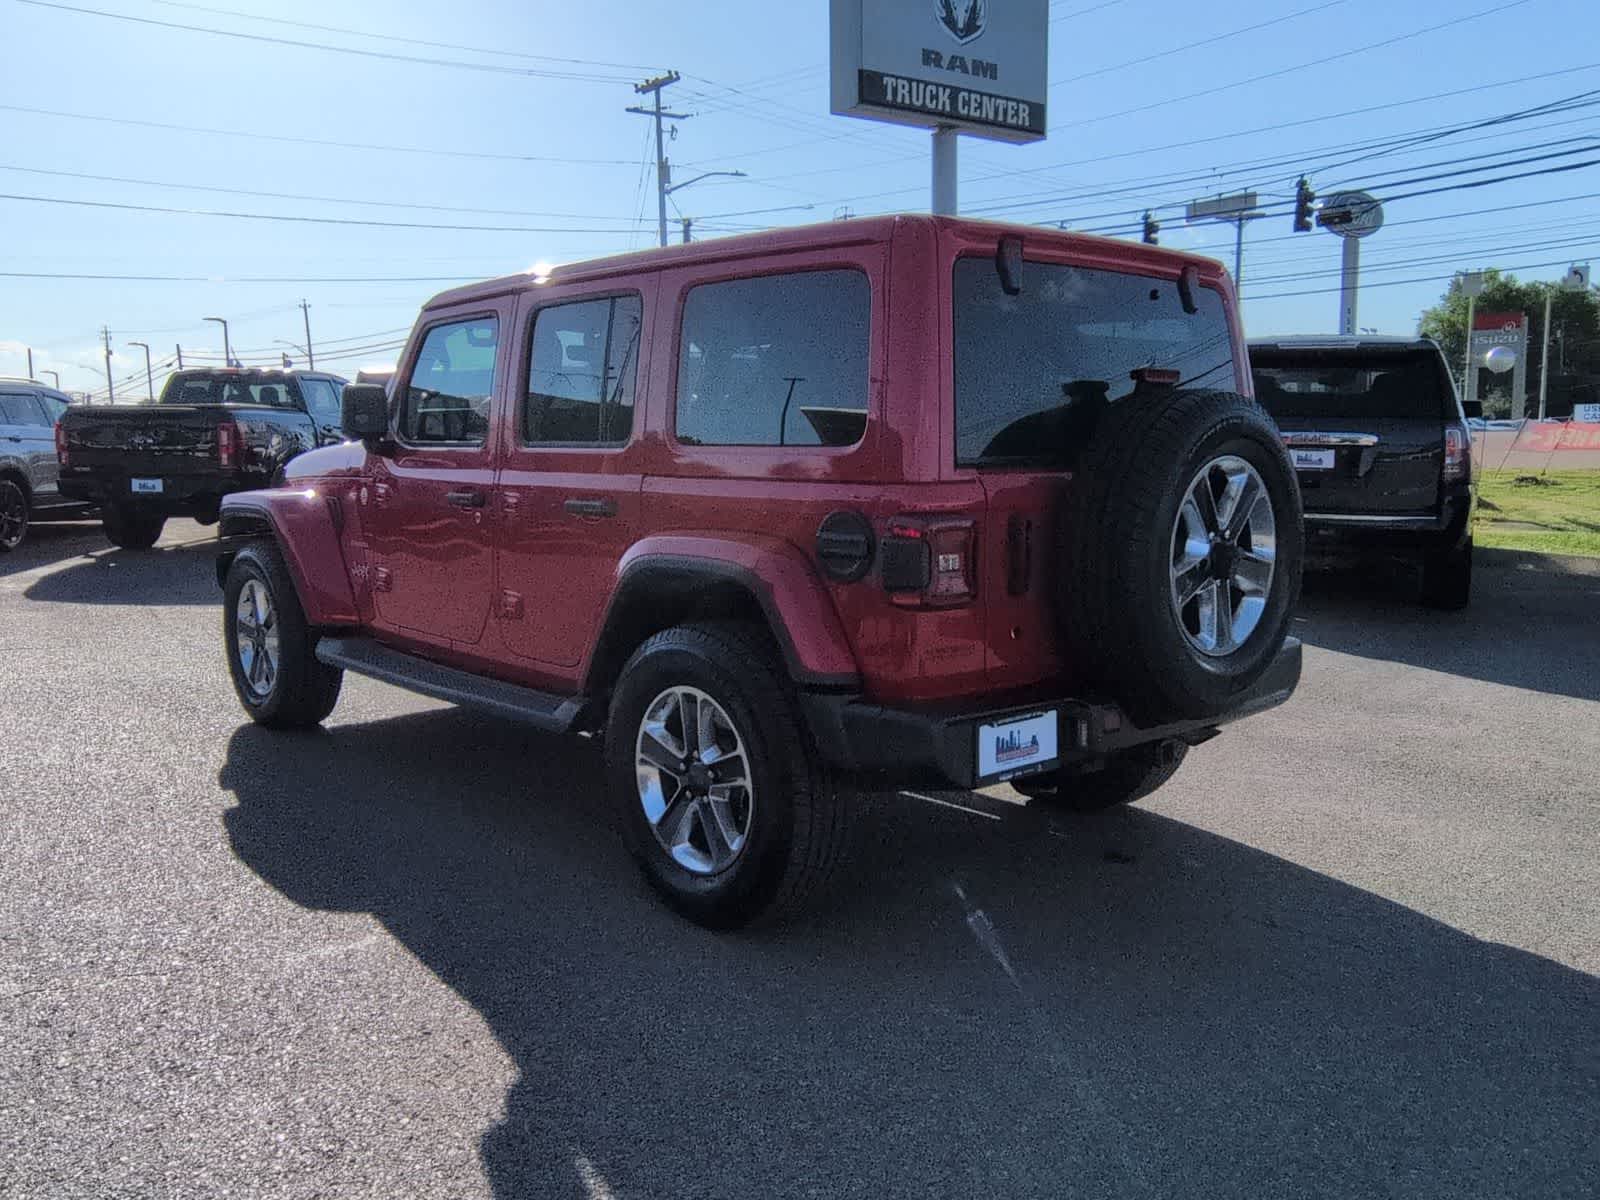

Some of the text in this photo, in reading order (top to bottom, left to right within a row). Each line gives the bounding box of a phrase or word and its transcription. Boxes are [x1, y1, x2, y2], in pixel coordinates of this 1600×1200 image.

[921, 48, 998, 81] RAM
[883, 76, 1030, 127] TRUCK CENTER
[1473, 335, 1519, 345] ISUZU
